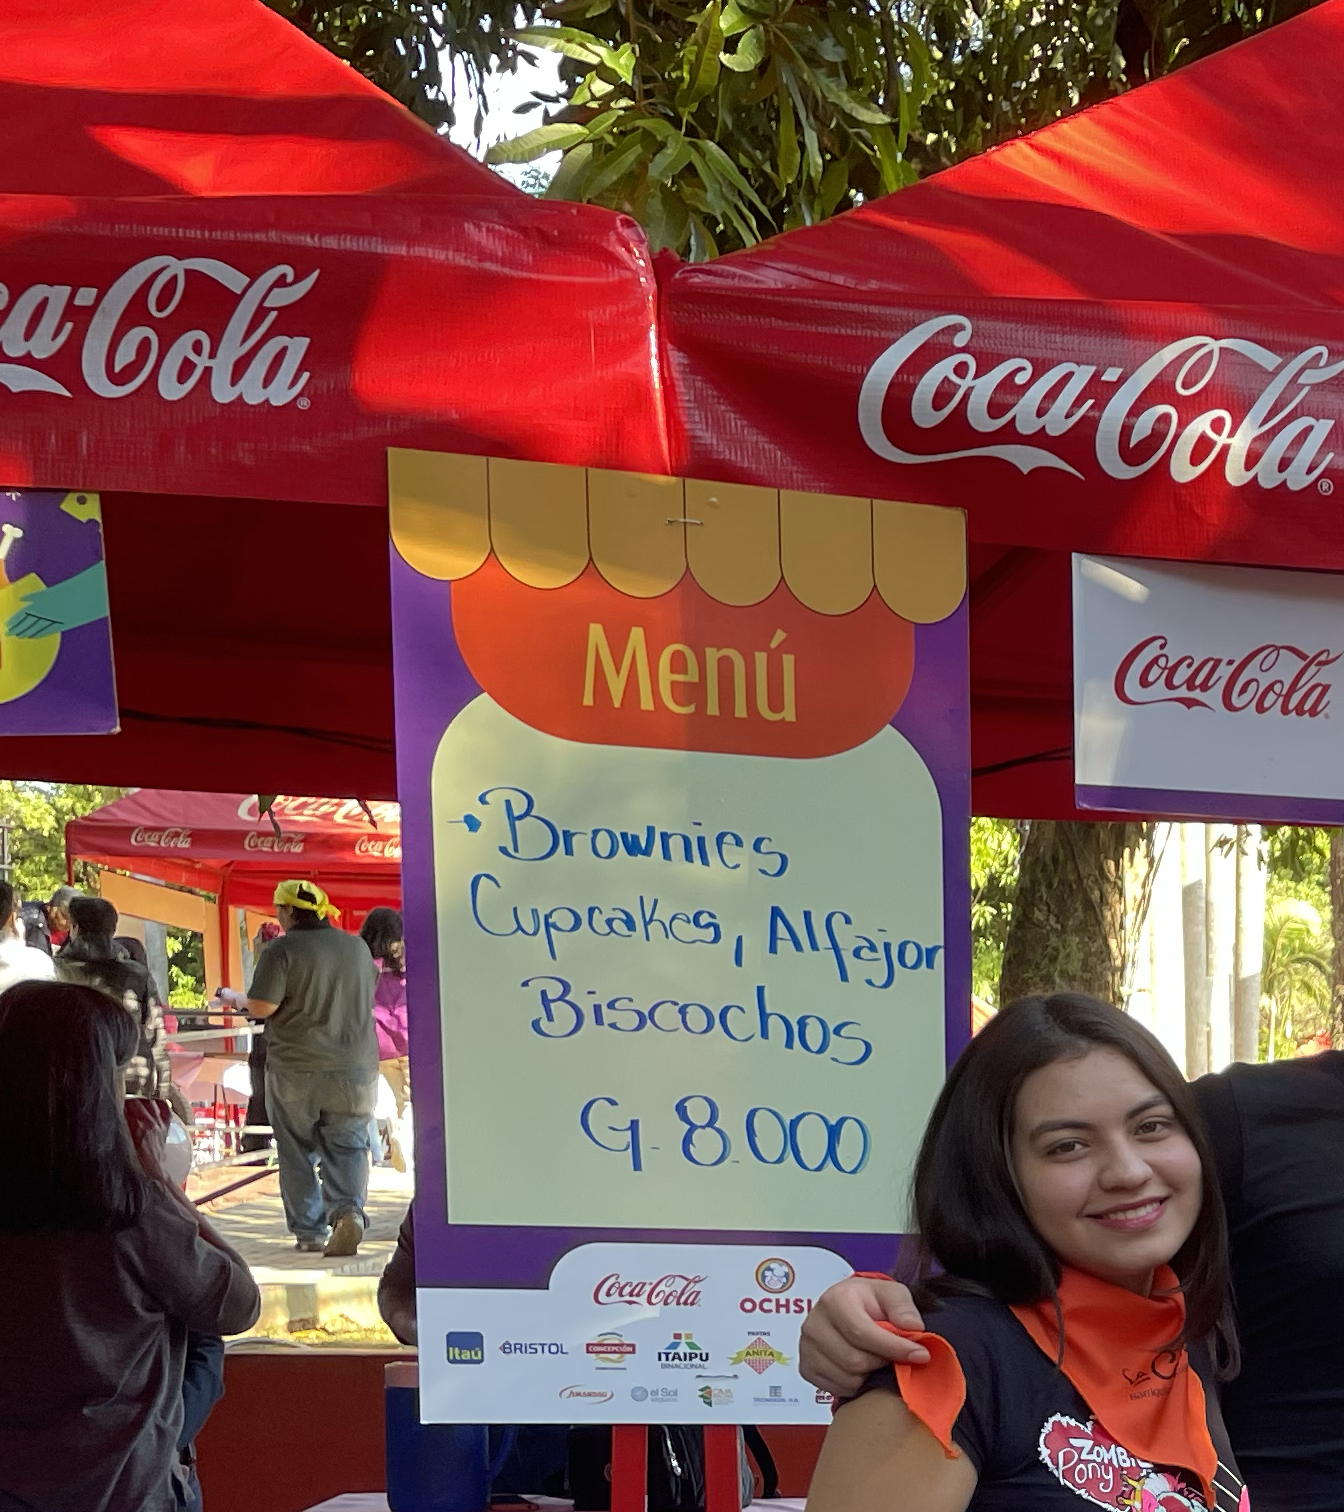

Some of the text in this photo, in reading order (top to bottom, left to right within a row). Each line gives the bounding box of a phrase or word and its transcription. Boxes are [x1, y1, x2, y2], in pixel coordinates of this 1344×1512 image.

[0, 255, 320, 407] a-Cola
[581, 622, 798, 723] Menú
[1113, 634, 1344, 719] Coca-Cola
[130, 826, 193, 849] Coca-Cola
[478, 787, 789, 878] Brownies
[768, 905, 944, 989] Alfajor
[520, 976, 873, 1066] Biscochos
[593, 1272, 708, 1308] Coca-Cola
[739, 1298, 812, 1315] OCHSI
[449, 1347, 482, 1360] Itaú
[501, 1342, 569, 1355] BRISTOL
[657, 1351, 709, 1362] ITAIPU
[745, 1349, 775, 1358] ANITA
[1058, 1448, 1113, 1493] Pony
